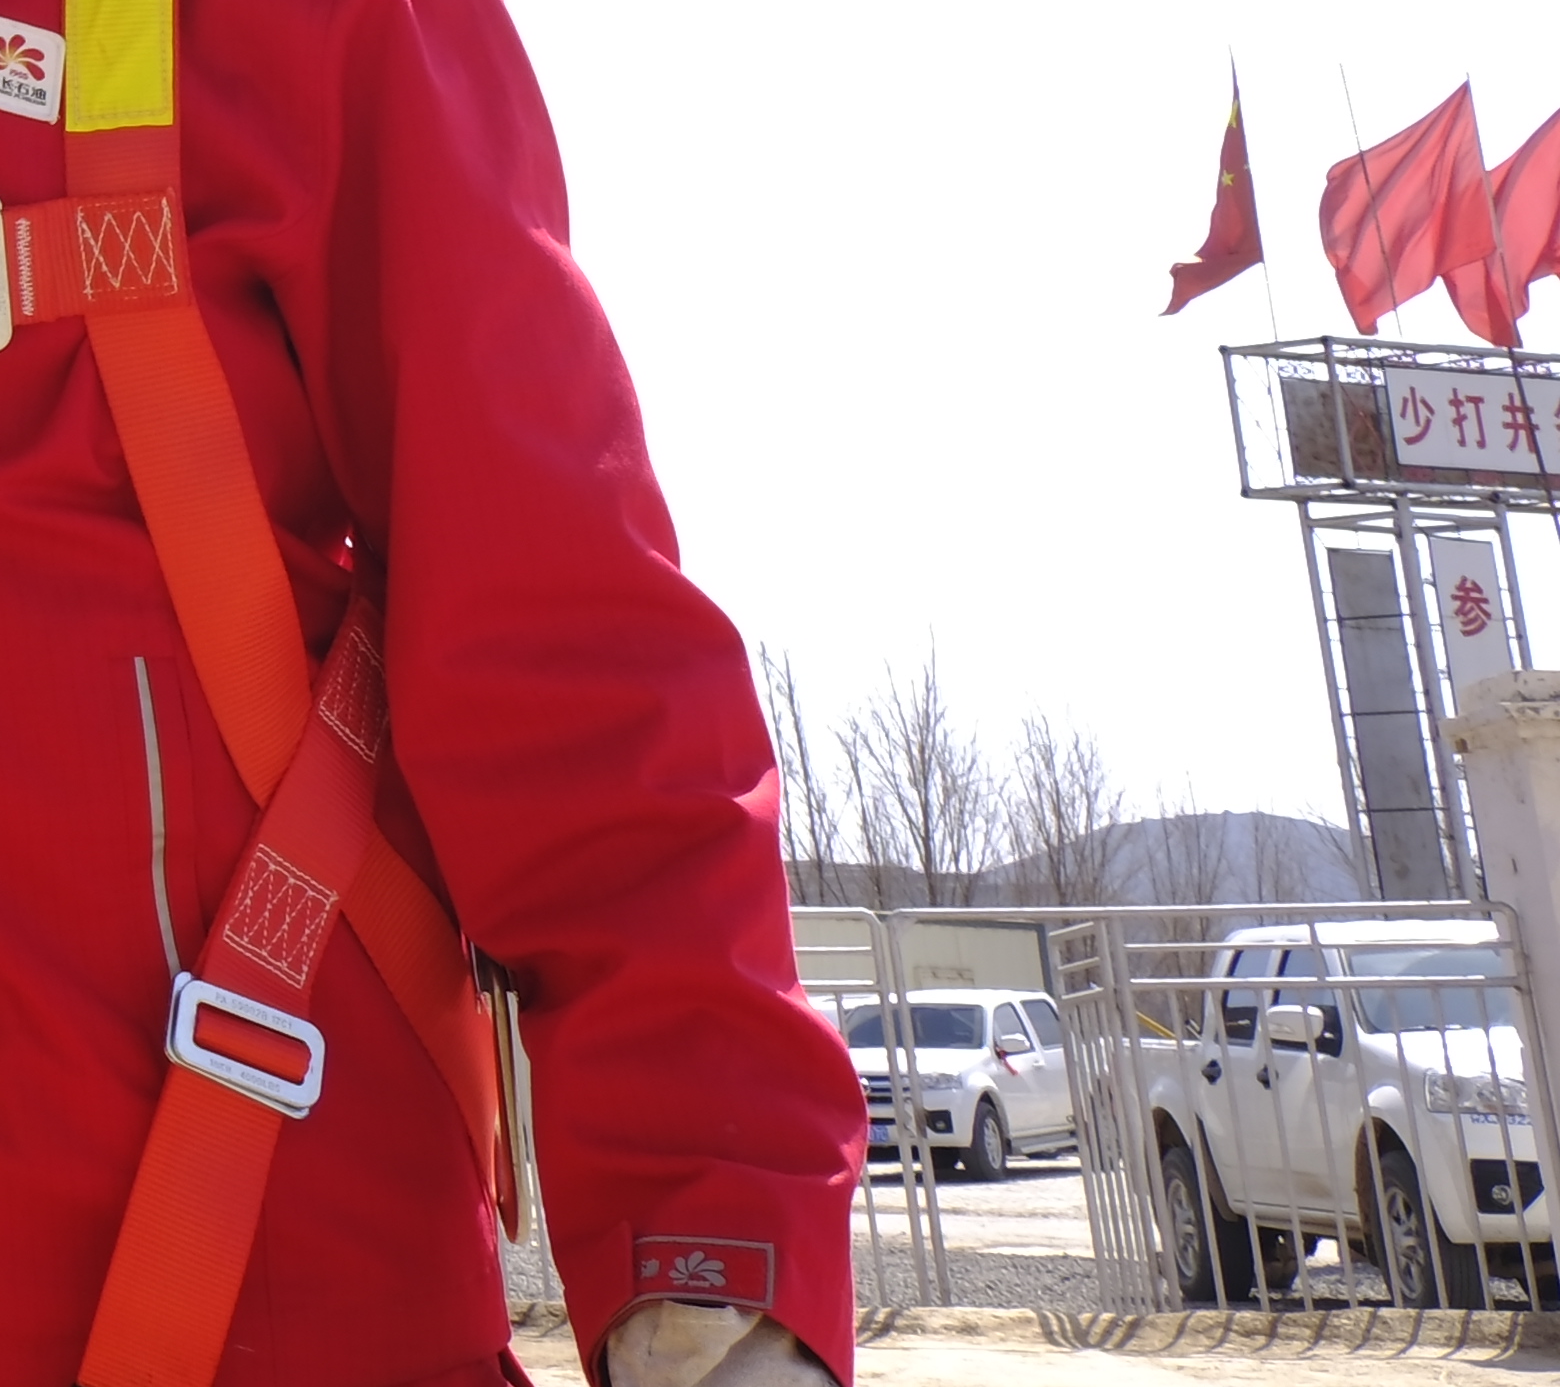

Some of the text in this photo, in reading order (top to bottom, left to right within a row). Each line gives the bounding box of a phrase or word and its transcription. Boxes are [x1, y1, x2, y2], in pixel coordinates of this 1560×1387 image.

[1400, 386, 1560, 453] 少打井
[1451, 576, 1492, 637] 参
